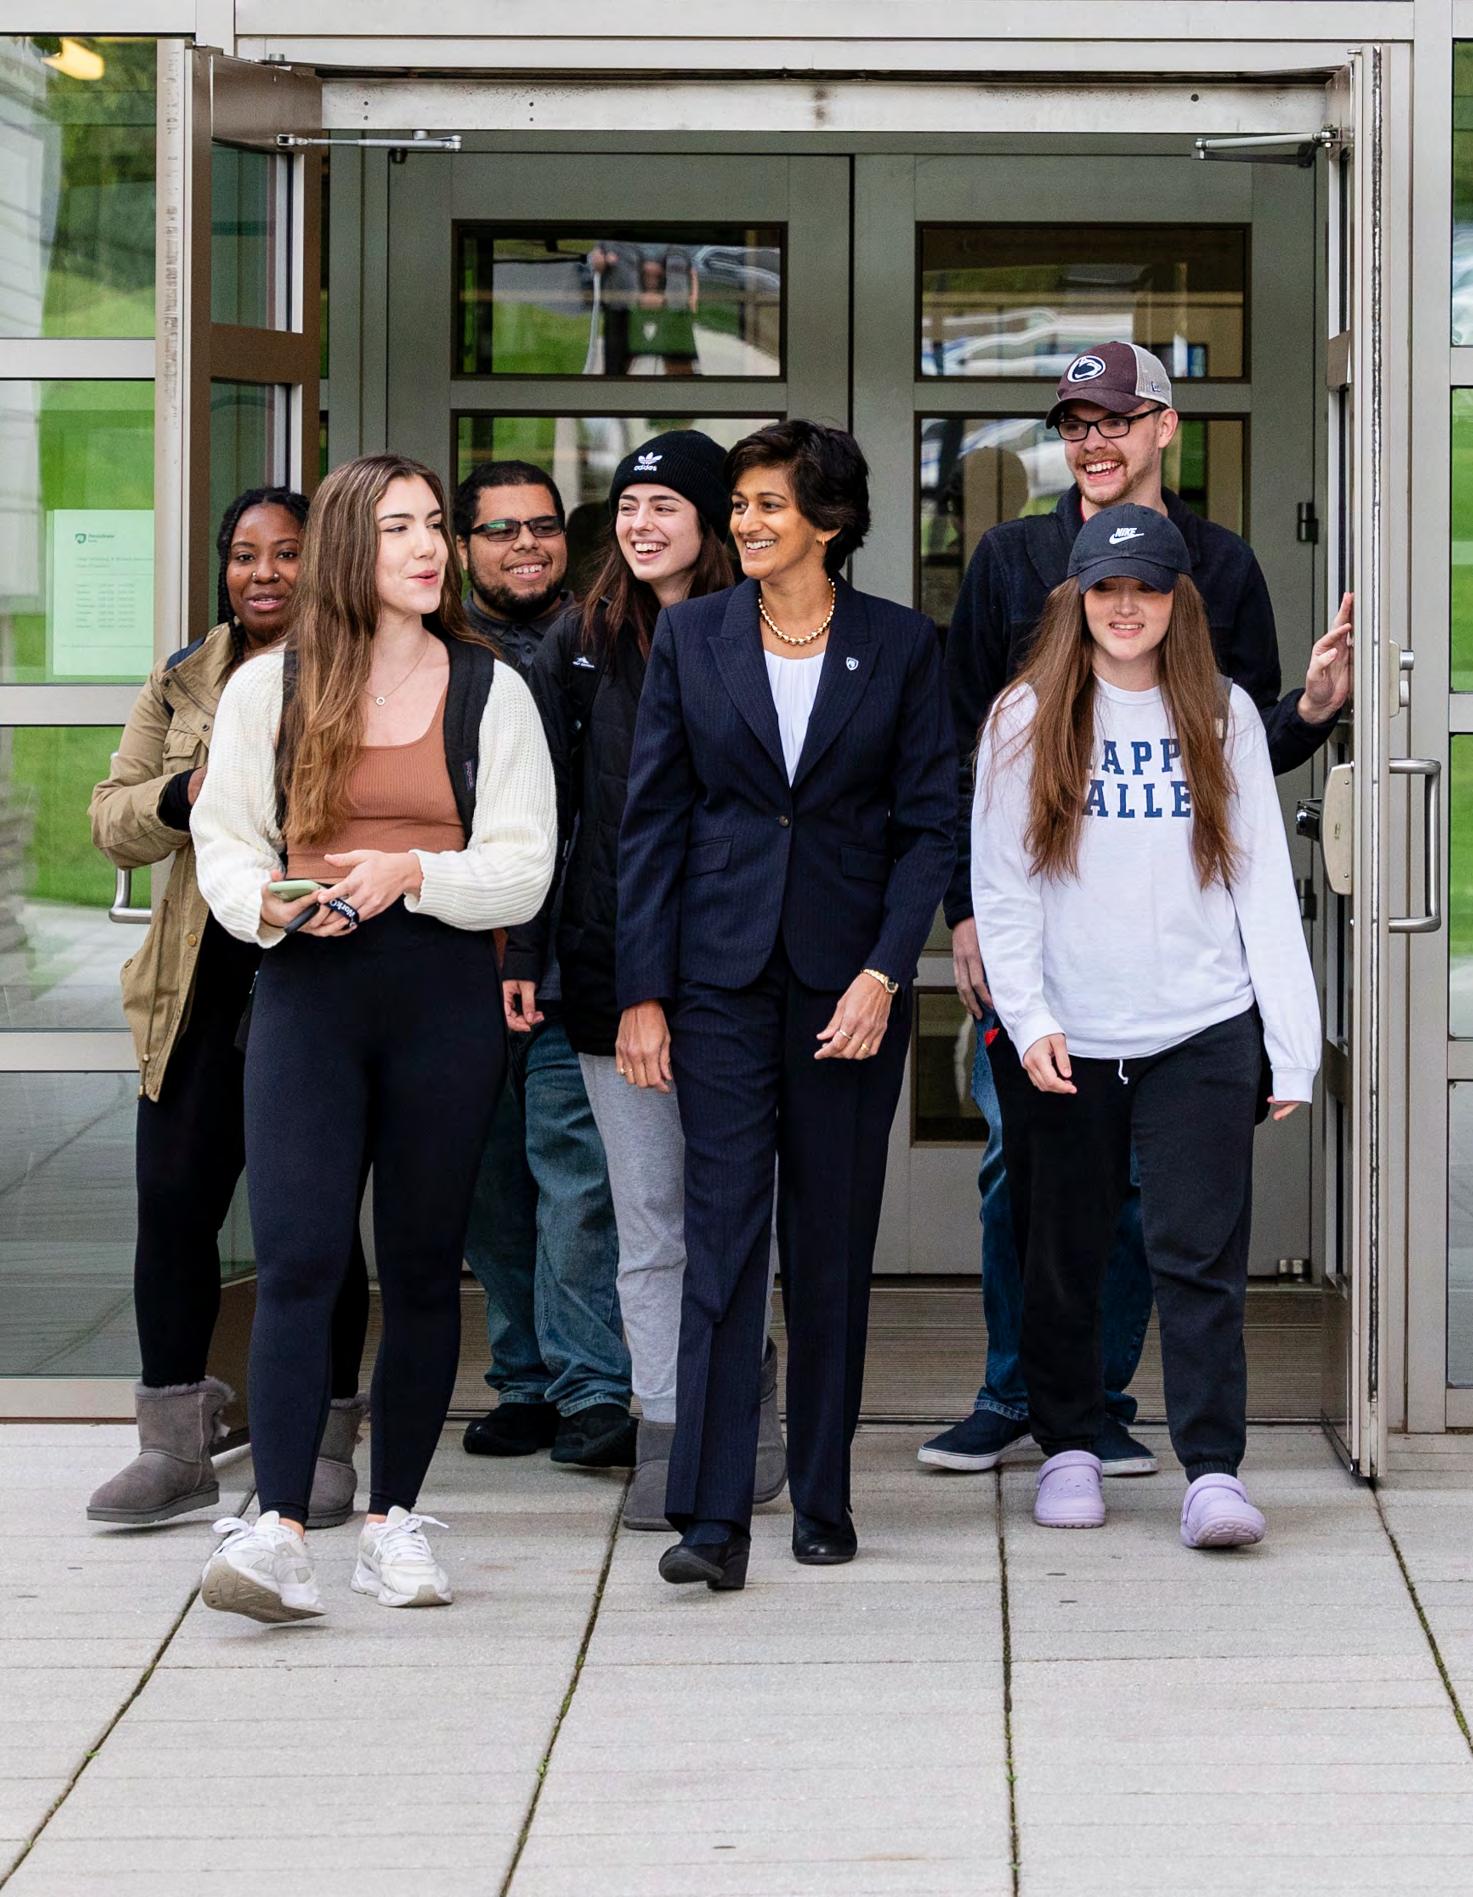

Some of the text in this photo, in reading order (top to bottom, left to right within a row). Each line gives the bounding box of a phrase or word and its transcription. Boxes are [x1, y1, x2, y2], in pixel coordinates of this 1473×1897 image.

[1114, 527, 1138, 538] NIKE
[1089, 737, 1182, 776] APP
[1082, 779, 1192, 819] ALLE
